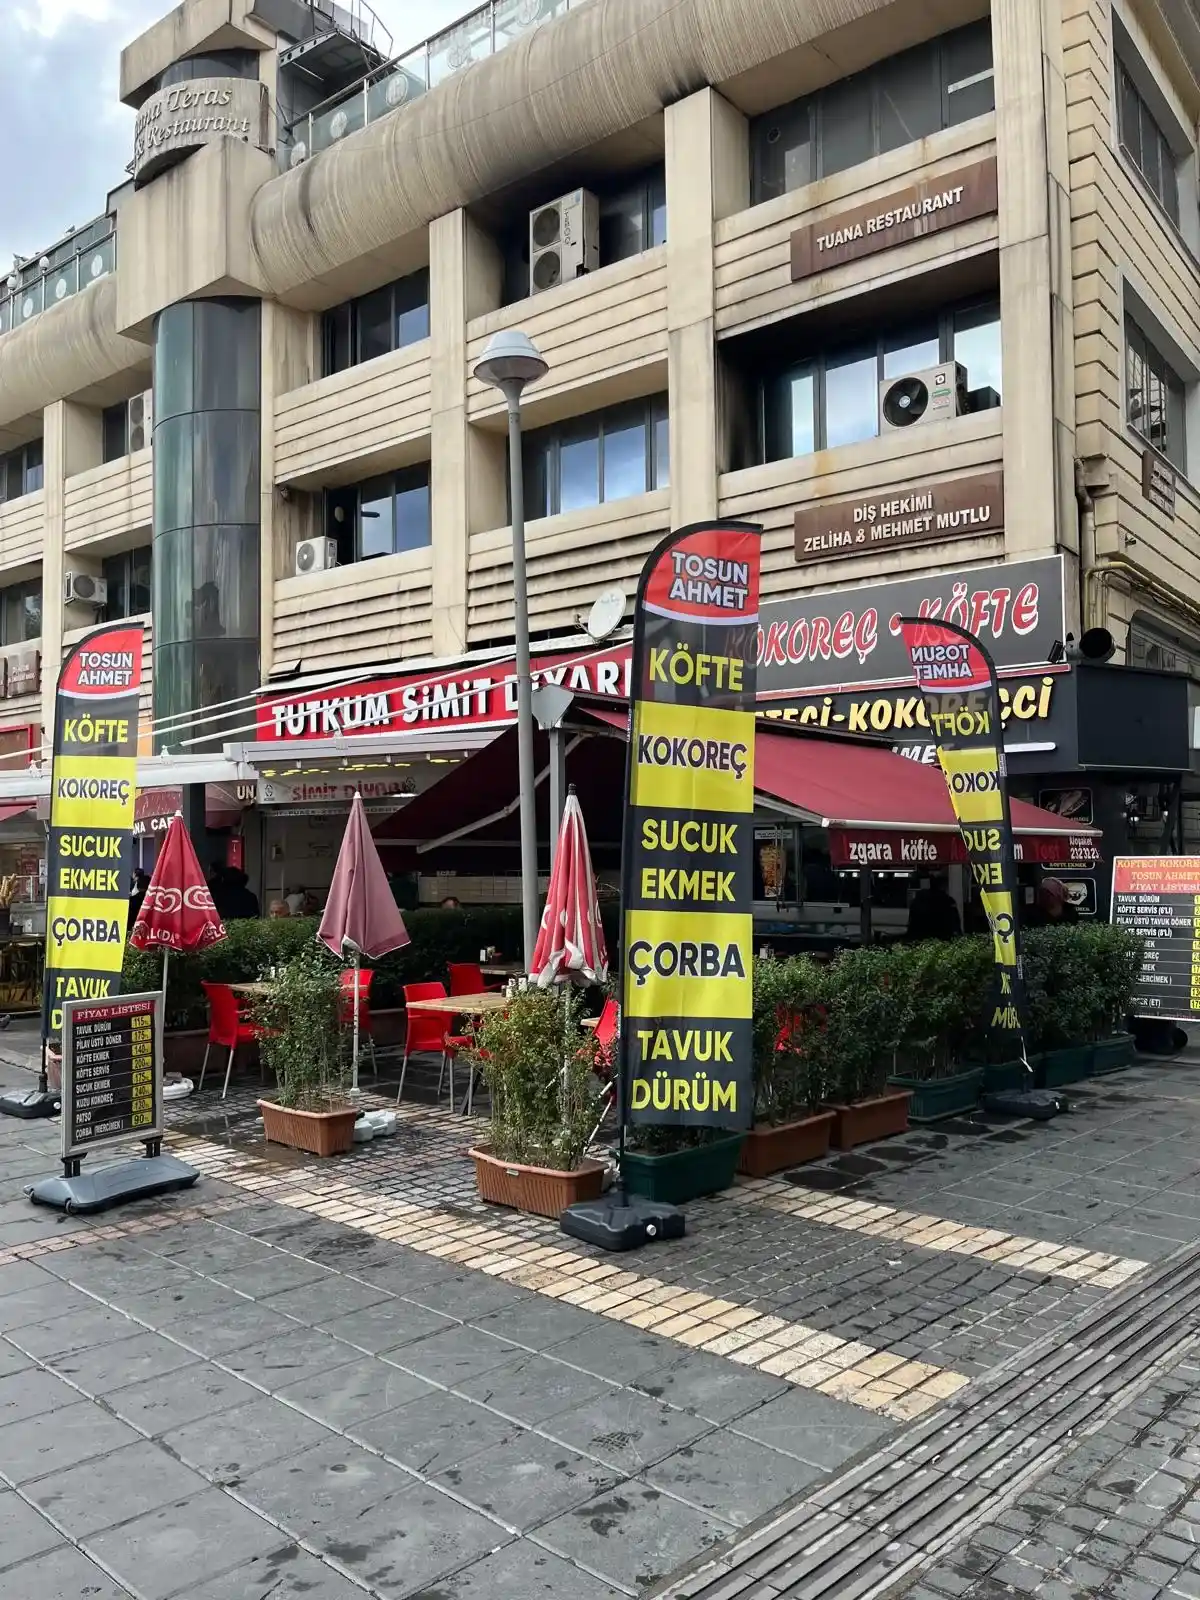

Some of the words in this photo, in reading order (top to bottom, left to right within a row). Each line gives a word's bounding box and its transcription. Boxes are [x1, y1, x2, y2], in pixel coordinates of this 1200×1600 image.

[167, 86, 232, 112] Teras
[147, 113, 250, 149] Restaurant
[816, 222, 864, 252] TUANA
[866, 186, 964, 235] RESTAURANT
[853, 503, 876, 524] DİŞ
[880, 490, 933, 518] HEKİMİ
[803, 530, 853, 553] ZELİHA
[855, 528, 866, 544] &
[870, 515, 933, 541] MEHMET
[936, 505, 991, 530] MUTLU
[671, 551, 749, 586] TOSUN
[669, 579, 748, 610] AHMET
[79, 651, 133, 669] TOSUN
[649, 642, 744, 691] KÖFTE
[77, 669, 133, 686] AHMET
[272, 692, 391, 738] TUTKUM
[402, 677, 493, 724] SİMİT
[63, 713, 129, 743] KÖFTE
[637, 734, 748, 780] KOKOREÇ
[57, 778, 130, 806] KOKOREÇ
[151, 816, 175, 831] CAF
[59, 834, 123, 858] SUCUK
[641, 818, 738, 854] SUCUK
[901, 838, 938, 861] köfte
[59, 867, 120, 892] EKMEK
[640, 868, 736, 902] EKMEK
[1130, 881, 1158, 891] FİYAT
[1131, 871, 1162, 880] TOSUN
[1117, 905, 1136, 914] KÖFTE
[1137, 905, 1157, 914] SERVİS
[1139, 894, 1160, 903] DÜRÜM
[52, 917, 121, 946] ÇORBA
[1116, 916, 1133, 925] PİLAV
[1151, 918, 1170, 926] TAVUK
[628, 940, 746, 986] ÇORBA
[56, 976, 111, 999] TAVUK
[77, 1008, 108, 1020] FİYAT
[111, 1001, 151, 1015] LİSTESİ
[76, 1025, 93, 1036] TAVUK
[76, 1038, 91, 1050] PİLAV
[636, 1029, 734, 1062] TAVUK
[76, 1053, 92, 1065] KÖFTE
[93, 1050, 110, 1061] EKMEK
[76, 1067, 92, 1080] KÖFTE
[93, 1063, 110, 1077] SERVİS
[76, 1083, 93, 1094] SUCUK
[93, 1079, 111, 1090] EKMEK
[90, 1092, 114, 1105] KOKOREÇ
[631, 1071, 737, 1113] DÜRÜM
[76, 1111, 92, 1124] PATSO
[76, 1126, 93, 1141] ÇORBA
